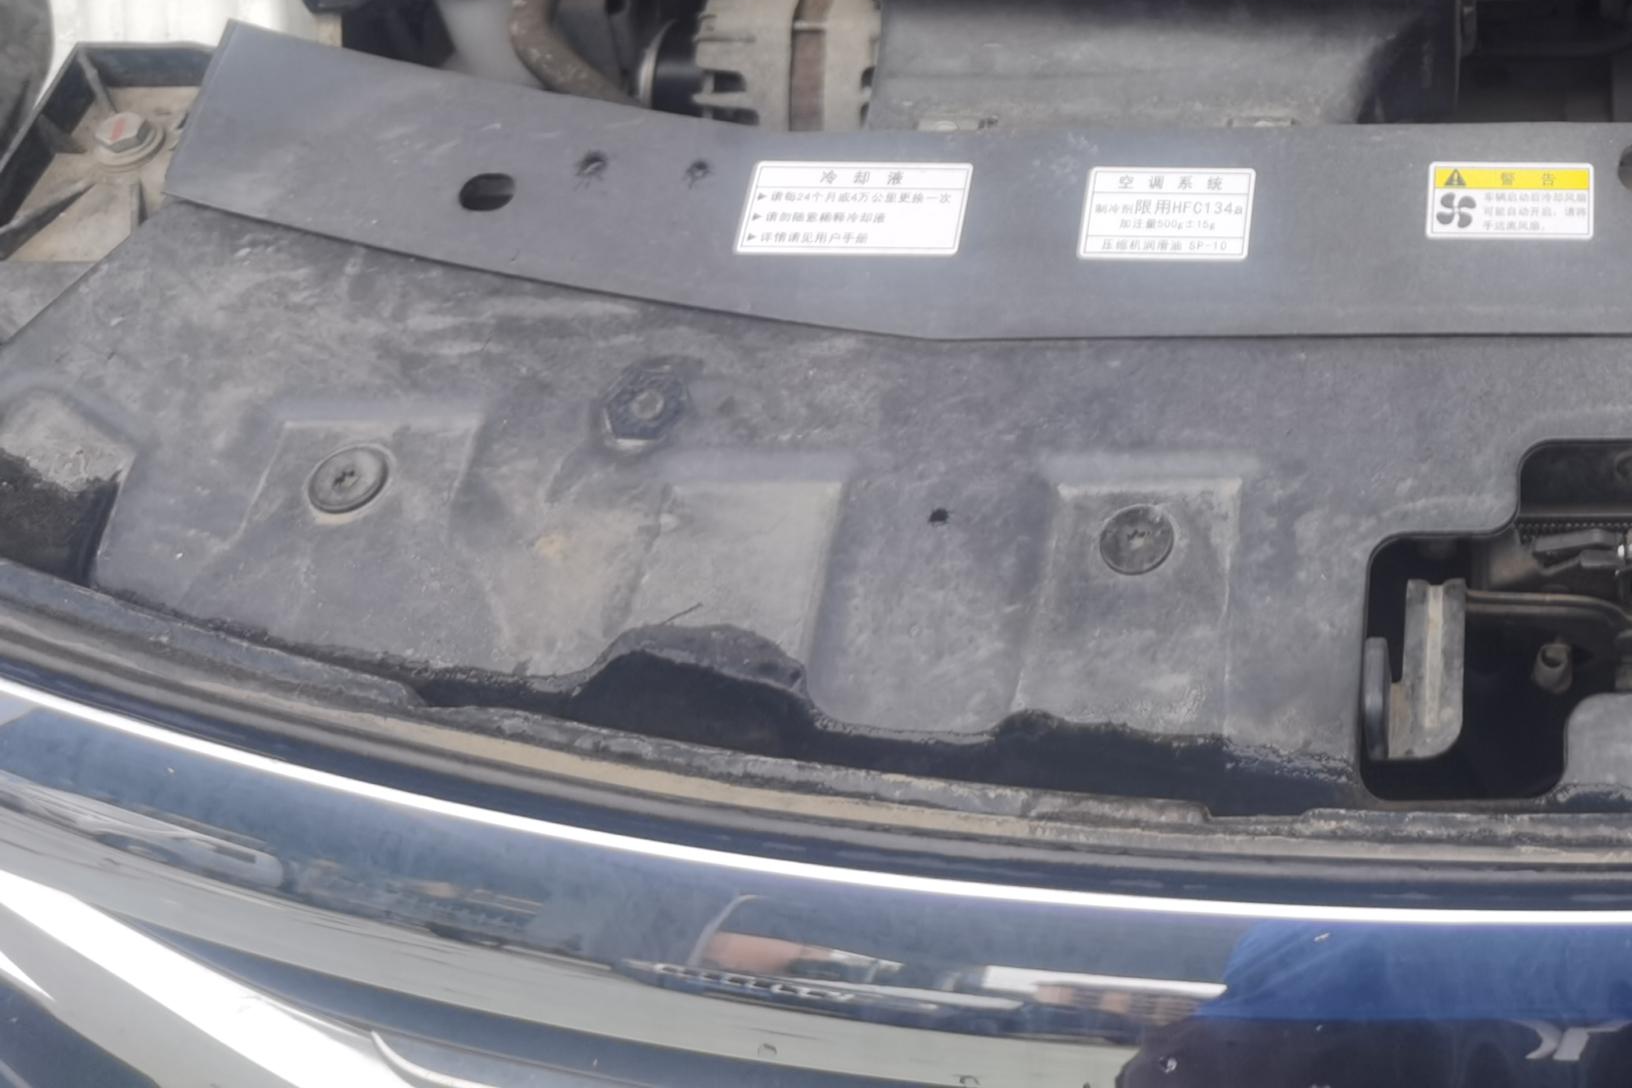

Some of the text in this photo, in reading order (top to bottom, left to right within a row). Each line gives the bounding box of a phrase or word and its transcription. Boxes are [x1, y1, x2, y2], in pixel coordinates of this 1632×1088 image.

[820, 170, 904, 186] 冷却液
[1118, 175, 1223, 191] 空调系统
[1500, 172, 1556, 186] 警告
